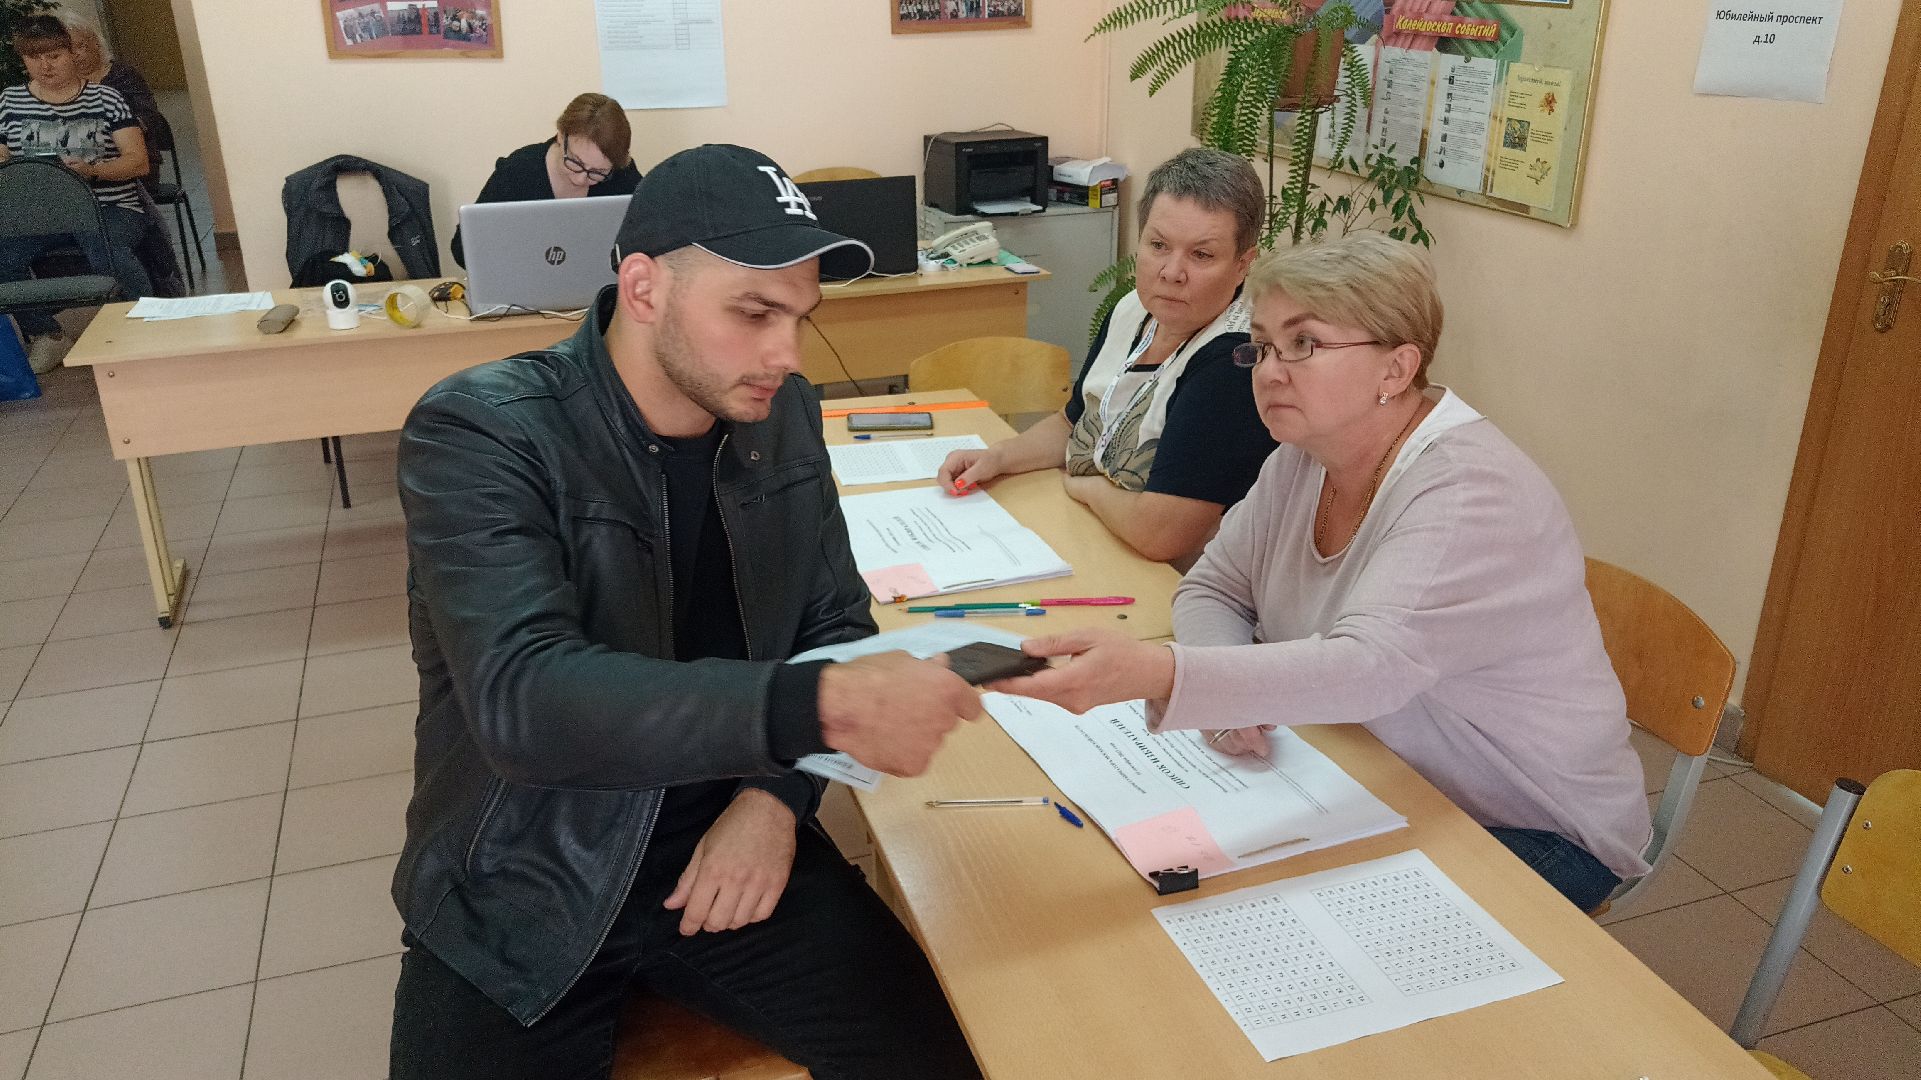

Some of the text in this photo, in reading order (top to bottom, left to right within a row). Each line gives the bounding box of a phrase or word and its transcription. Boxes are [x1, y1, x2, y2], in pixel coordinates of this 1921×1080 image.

[1715, 9, 1823, 25] Юбилейный проспект
[1455, 23, 1497, 37] событий
[1752, 33, 1776, 45] д.10
[757, 165, 818, 221] LA
[546, 246, 566, 266] hp
